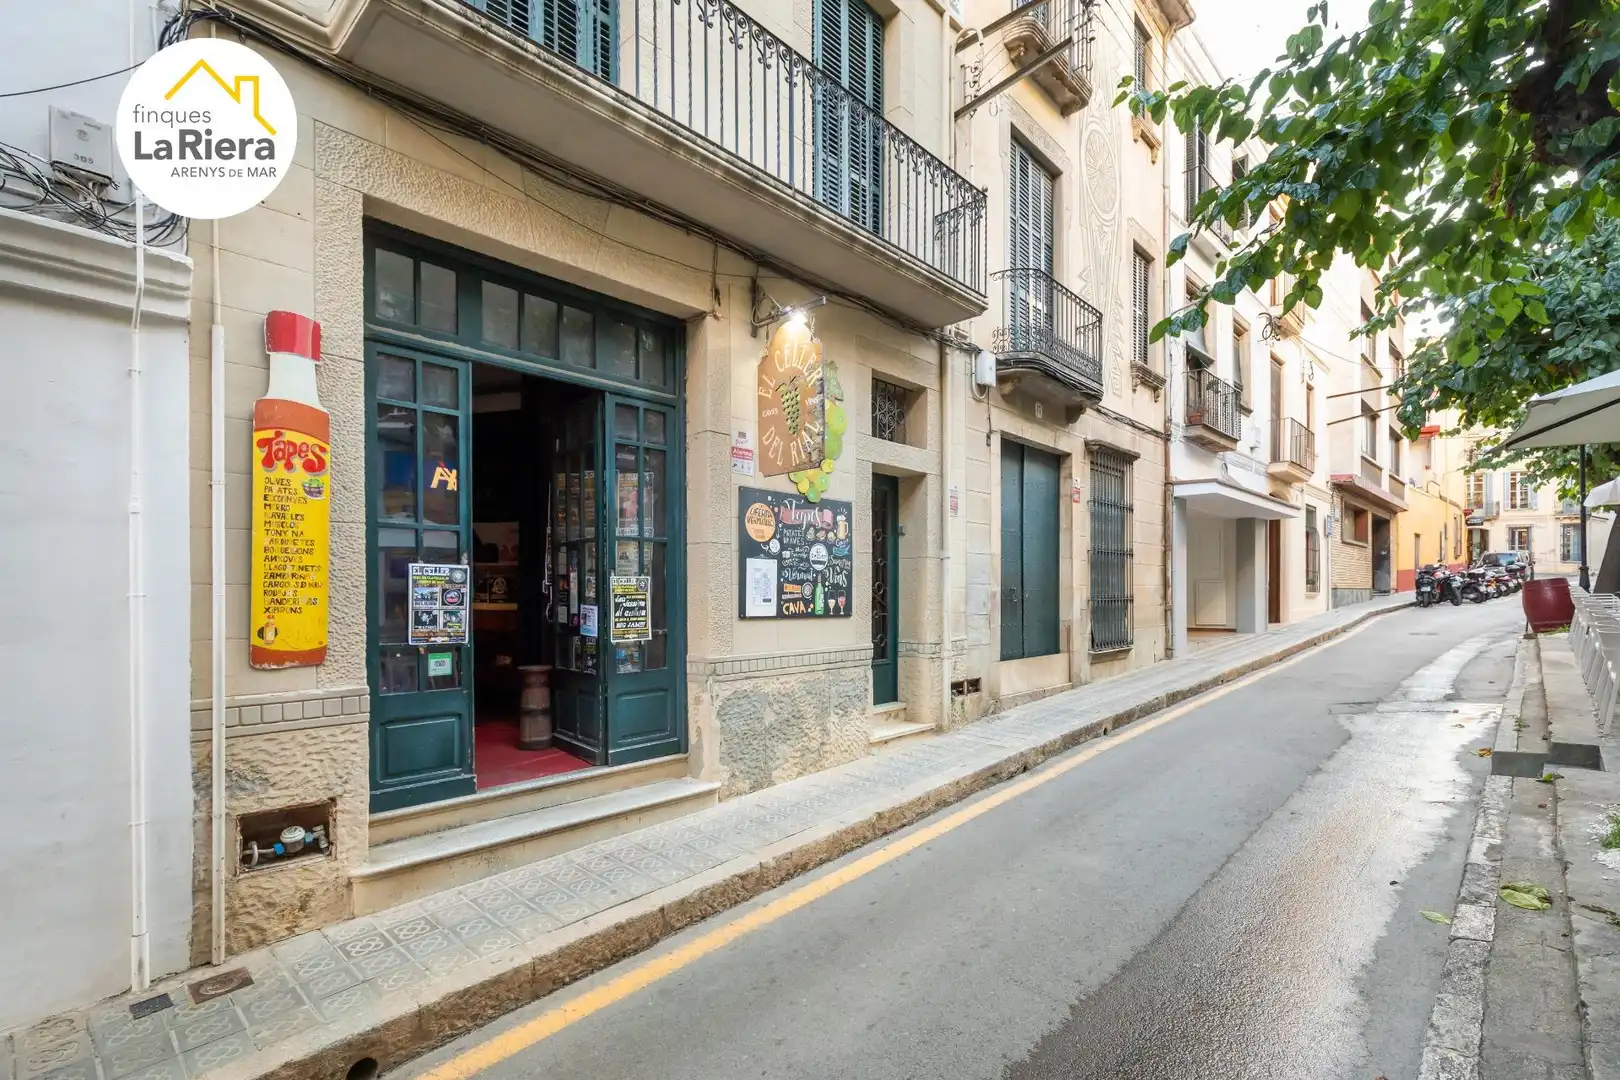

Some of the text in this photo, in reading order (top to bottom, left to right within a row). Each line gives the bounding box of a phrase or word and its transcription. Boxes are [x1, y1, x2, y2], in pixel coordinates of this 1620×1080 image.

[758, 374, 776, 399] EL
[264, 476, 292, 487] OLVES
[263, 485, 299, 497] PAATES
[264, 528, 305, 539] TONYNA
[782, 601, 806, 615] CAVA
